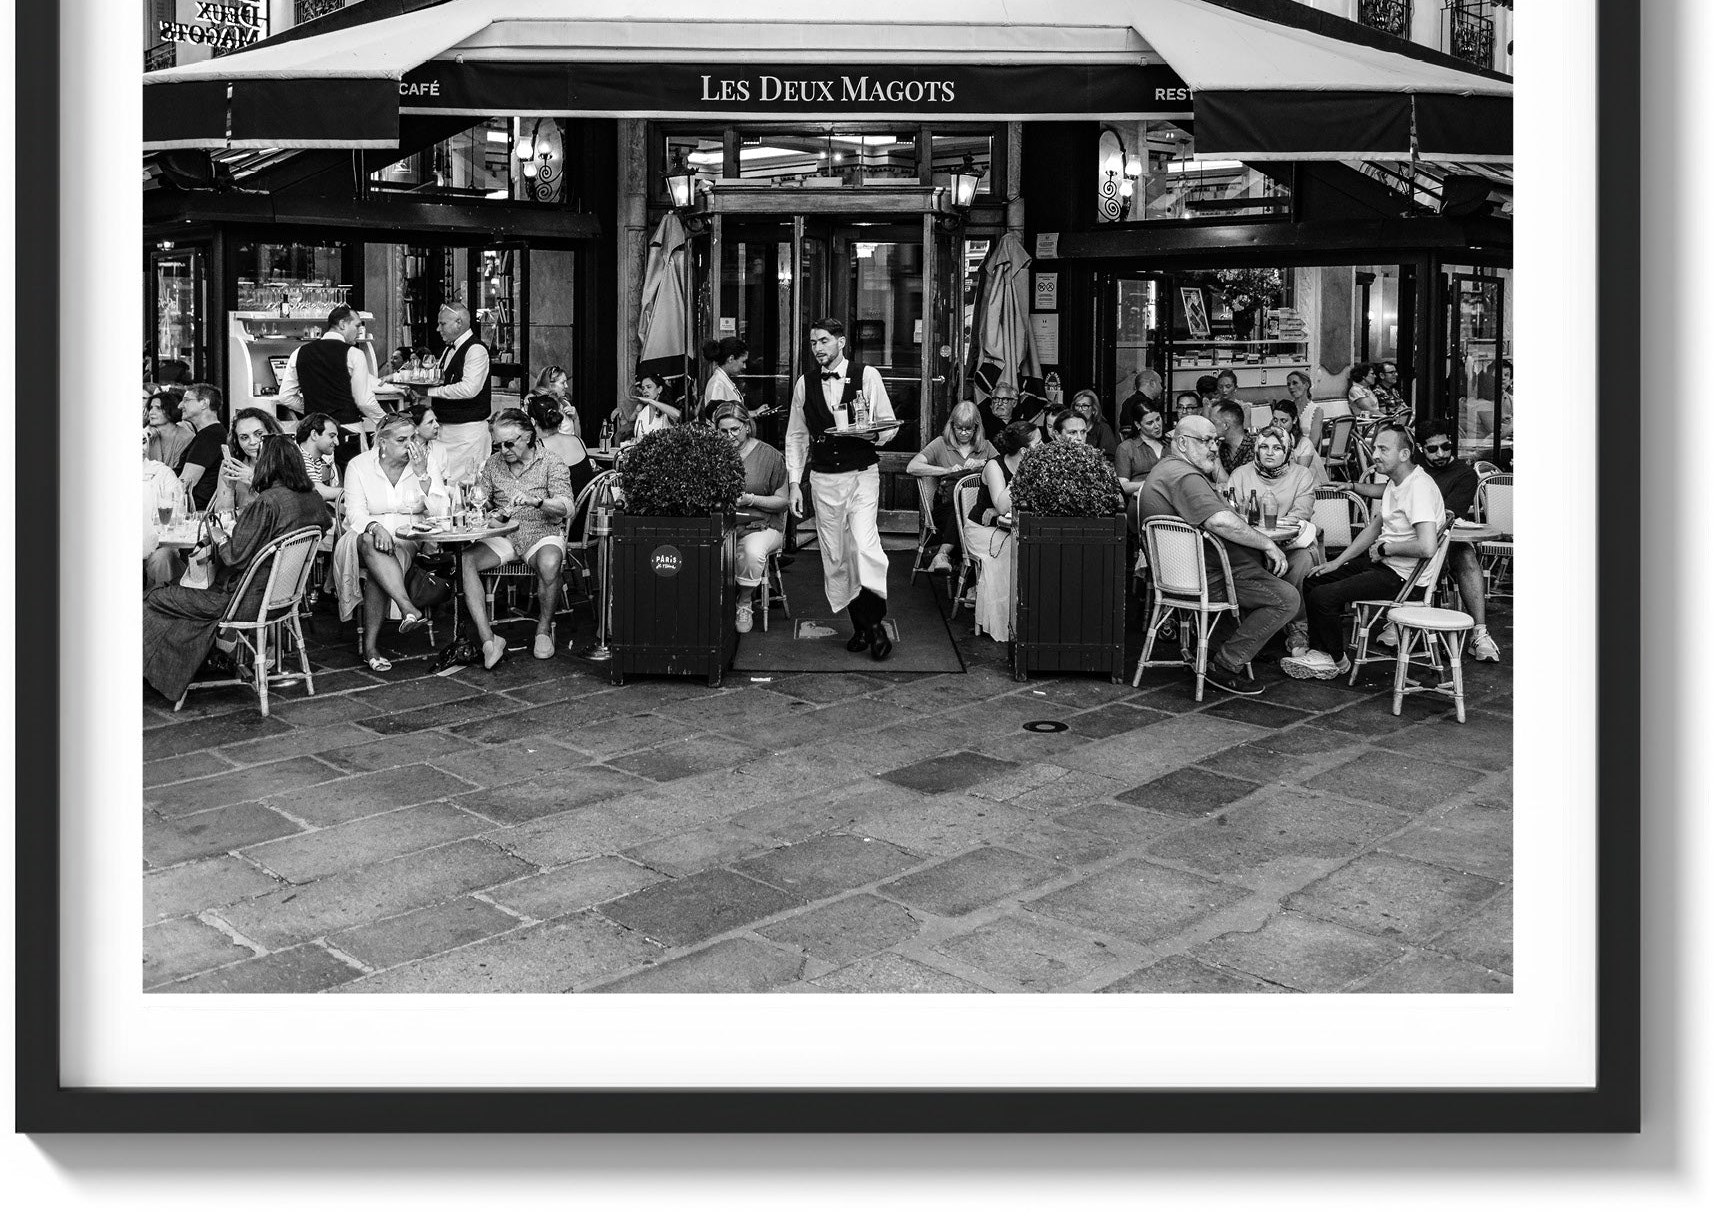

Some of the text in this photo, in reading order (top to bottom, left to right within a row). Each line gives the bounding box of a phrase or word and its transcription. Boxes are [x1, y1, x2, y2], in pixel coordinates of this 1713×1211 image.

[399, 80, 440, 96] CAFÉ
[700, 75, 955, 102] LES DEUX MAGOTS
